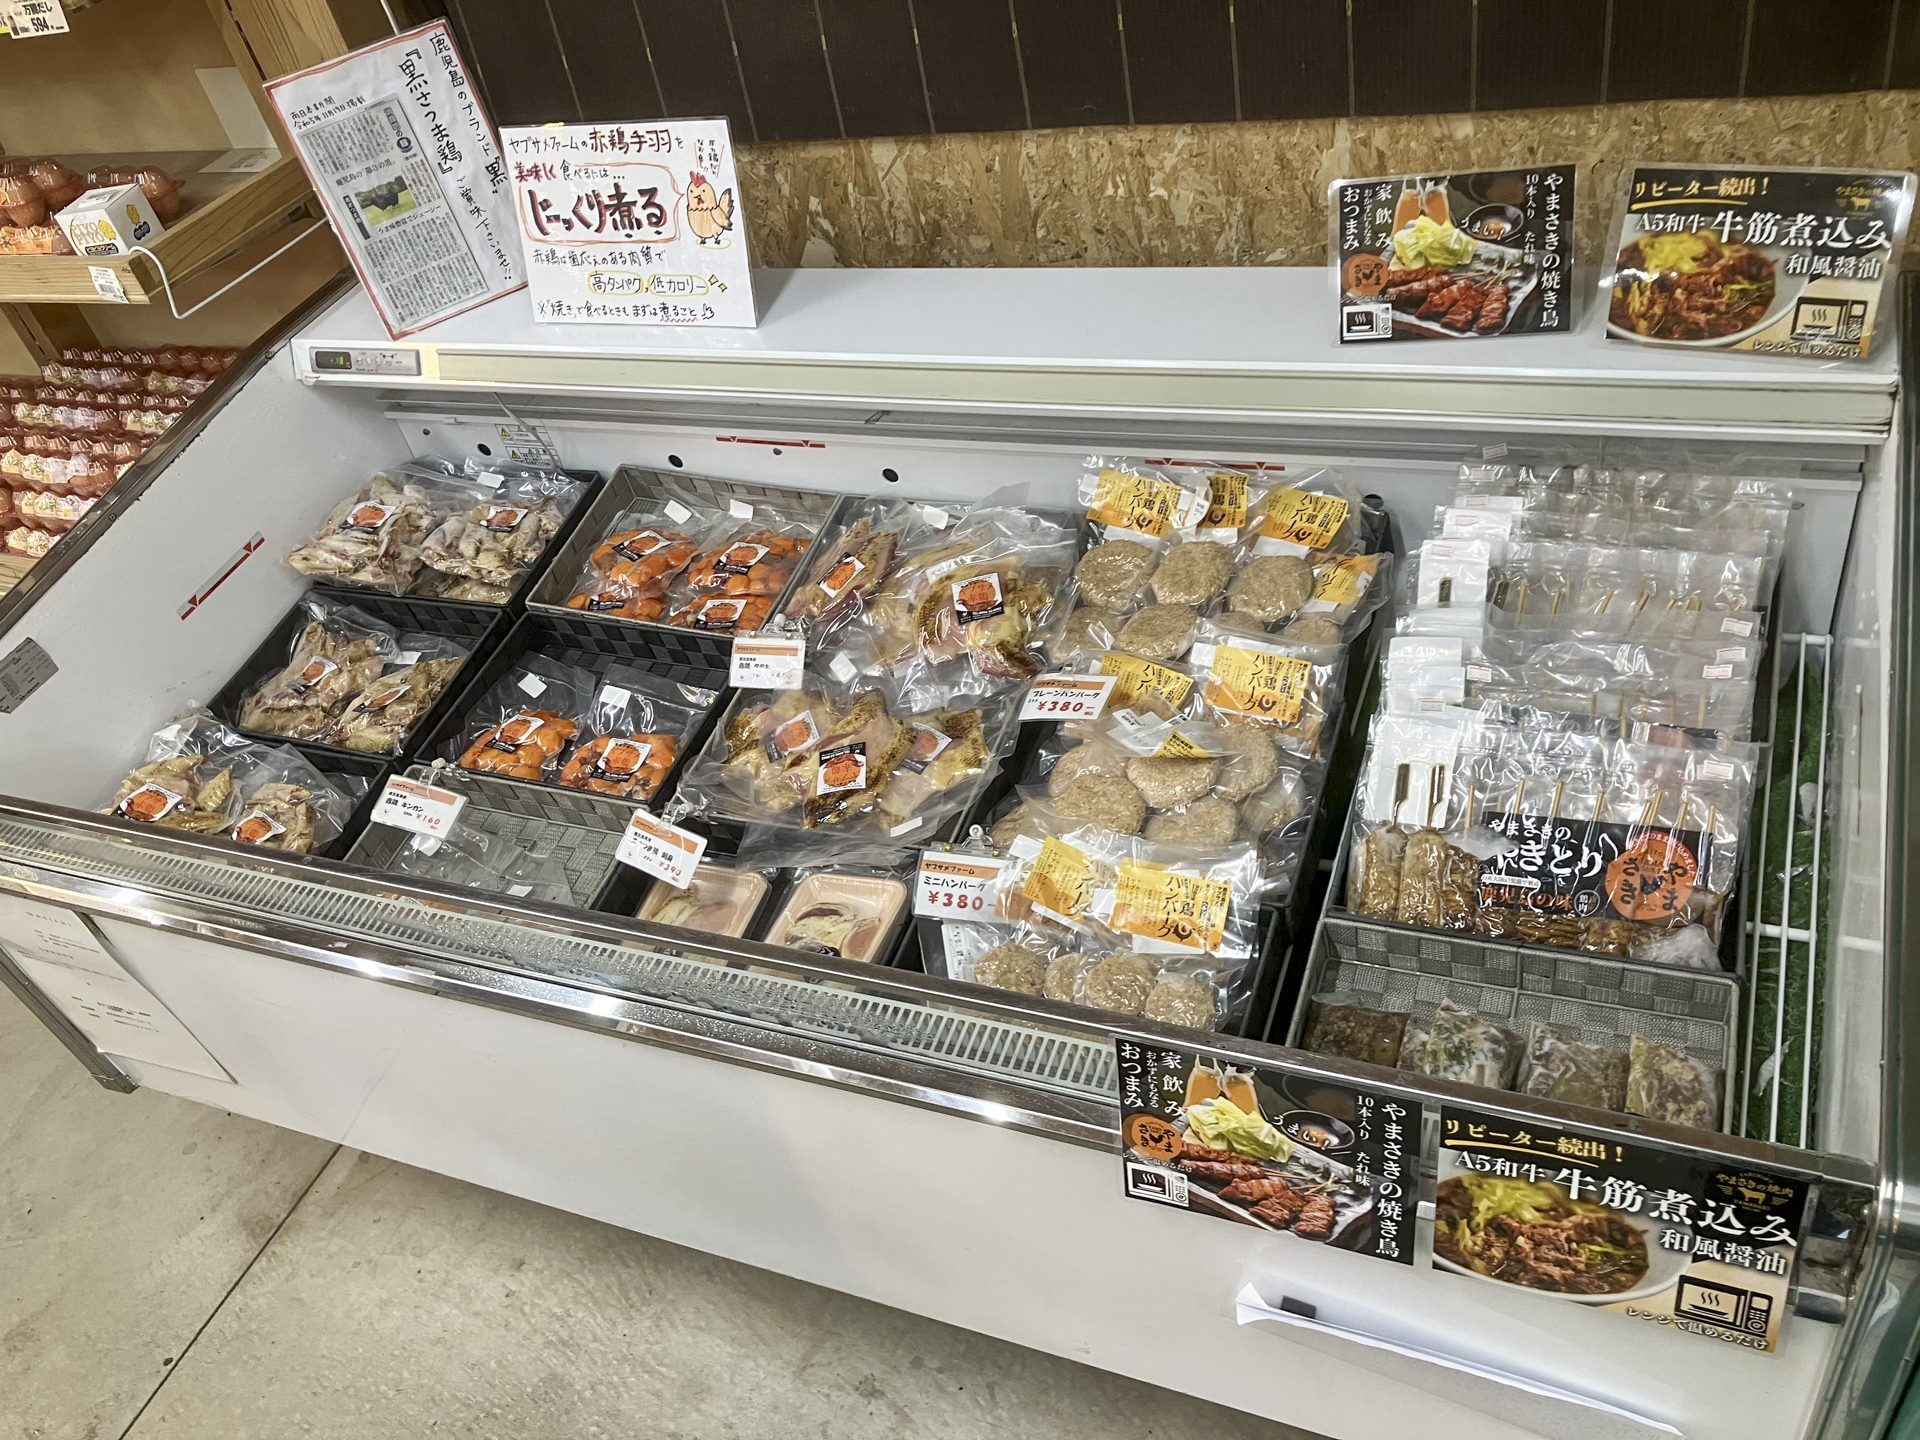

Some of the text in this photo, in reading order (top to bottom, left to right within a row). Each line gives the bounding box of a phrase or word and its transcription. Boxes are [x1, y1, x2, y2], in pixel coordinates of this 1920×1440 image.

[31, 17, 49, 32] 594
[528, 183, 668, 236] じっくり煮る
[1343, 187, 1360, 251] おつまみ
[1375, 184, 1392, 249] 家飲み
[1523, 174, 1539, 265] 10本入り たれ味
[1635, 210, 1892, 251] A5和牛 牛筋煮込み
[1540, 172, 1564, 329] やまさきの焼き鳥
[1785, 254, 1882, 280] 和風醤油
[1124, 478, 1147, 528] ハンバーグ
[1281, 494, 1312, 539] ハンバーグ
[1304, 513, 1318, 525] 鶏
[1137, 665, 1155, 694] ハンバ
[1244, 654, 1265, 711] ハンバーグ
[1264, 675, 1277, 690] 鶏
[401, 802, 424, 812] キンカン
[924, 876, 986, 892] ミニハンバーグ
[1157, 877, 1181, 938] ハンバーグ
[1179, 901, 1195, 917] 鶏
[1120, 1042, 1145, 1108] おつまみ
[1145, 1050, 1159, 1108] おかずにもなる
[1161, 1051, 1184, 1116] 家飲み
[1354, 1094, 1374, 1187] 10本入り たれ味
[1375, 1102, 1408, 1259] やまさきの焼き鳥
[1454, 1149, 1798, 1247] A5和牛 牛筋煮込み
[1716, 1173, 1794, 1197] やまさきの焼肉
[1659, 1229, 1787, 1276] 和風醤油
[1627, 1307, 1770, 1351] レンジで温めるだけ
